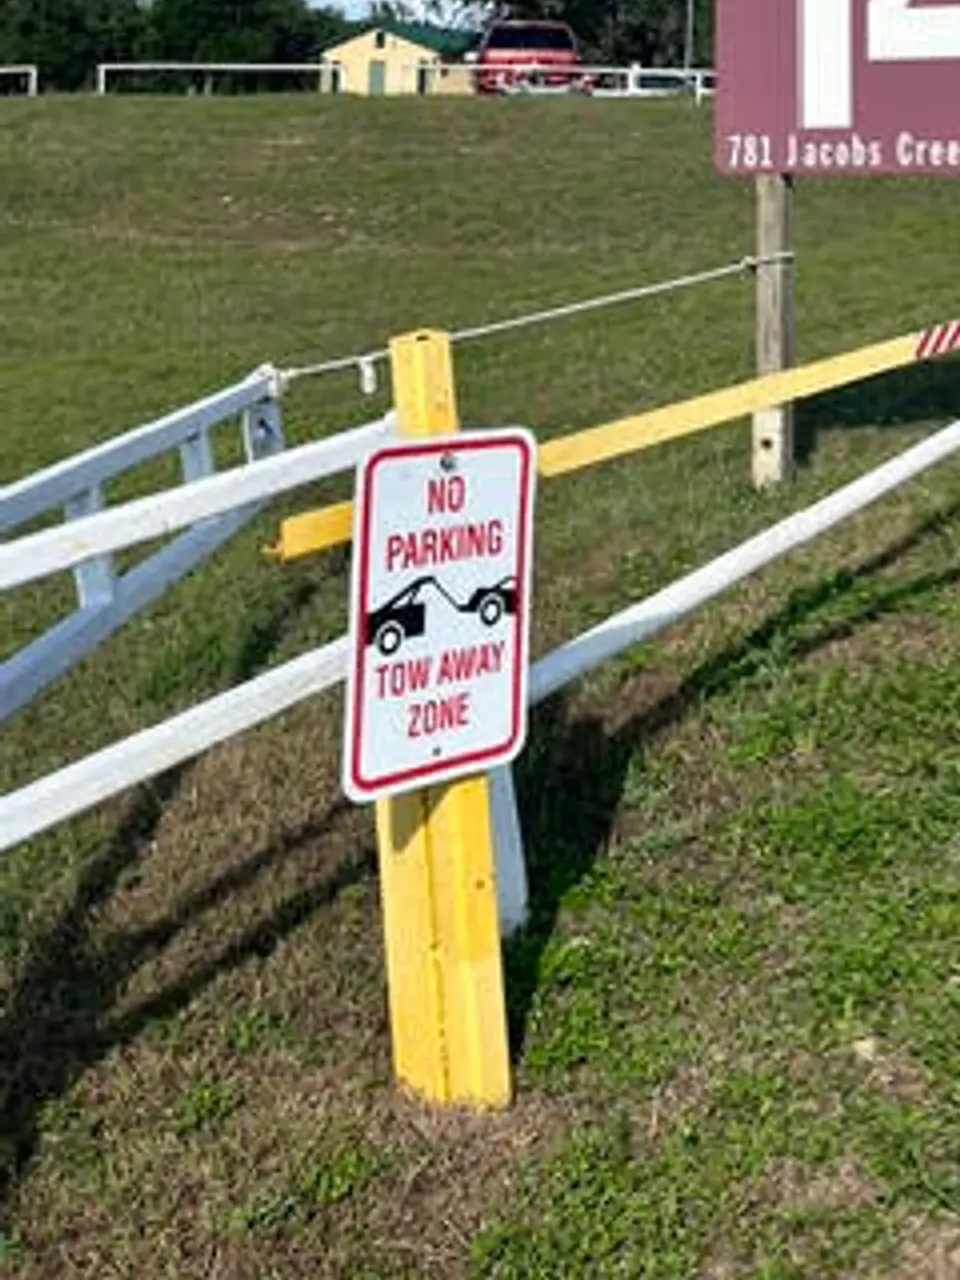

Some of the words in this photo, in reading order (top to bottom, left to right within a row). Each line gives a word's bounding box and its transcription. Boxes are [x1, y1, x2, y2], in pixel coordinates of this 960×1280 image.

[727, 135, 772, 168] 781
[786, 134, 882, 168] Jacobs
[426, 476, 465, 515] NO
[386, 519, 503, 571] PARKING
[376, 656, 430, 698] TOW
[436, 640, 505, 686] AWAY
[408, 694, 470, 737] ZONE
